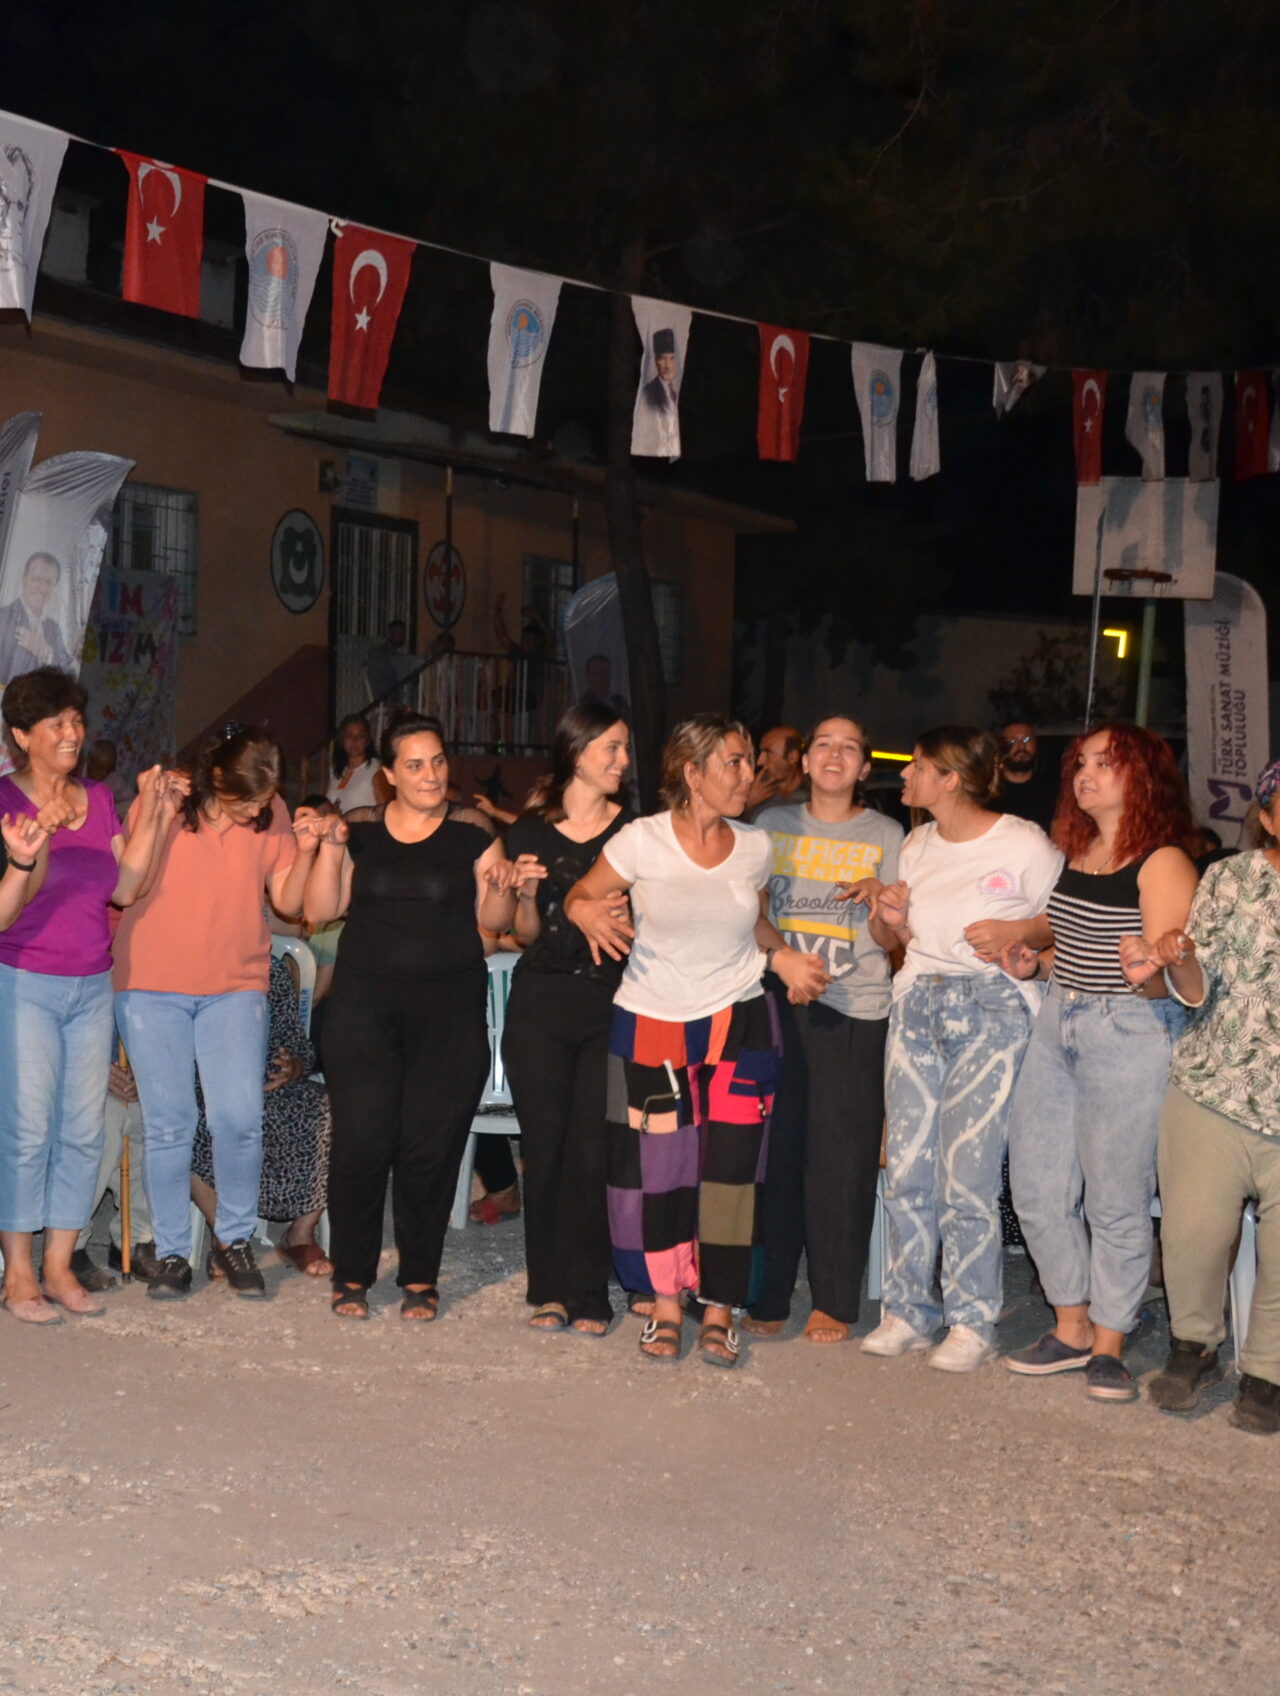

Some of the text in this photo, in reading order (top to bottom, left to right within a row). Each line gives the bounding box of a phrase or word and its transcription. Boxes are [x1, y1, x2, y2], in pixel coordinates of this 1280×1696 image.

[1220, 681, 1233, 733] SANAT
[1233, 690, 1247, 778] TOPLULUĞU
[1218, 736, 1234, 776] TÜRK
[771, 833, 879, 871] HILFIGER
[783, 860, 854, 882] DENIM
